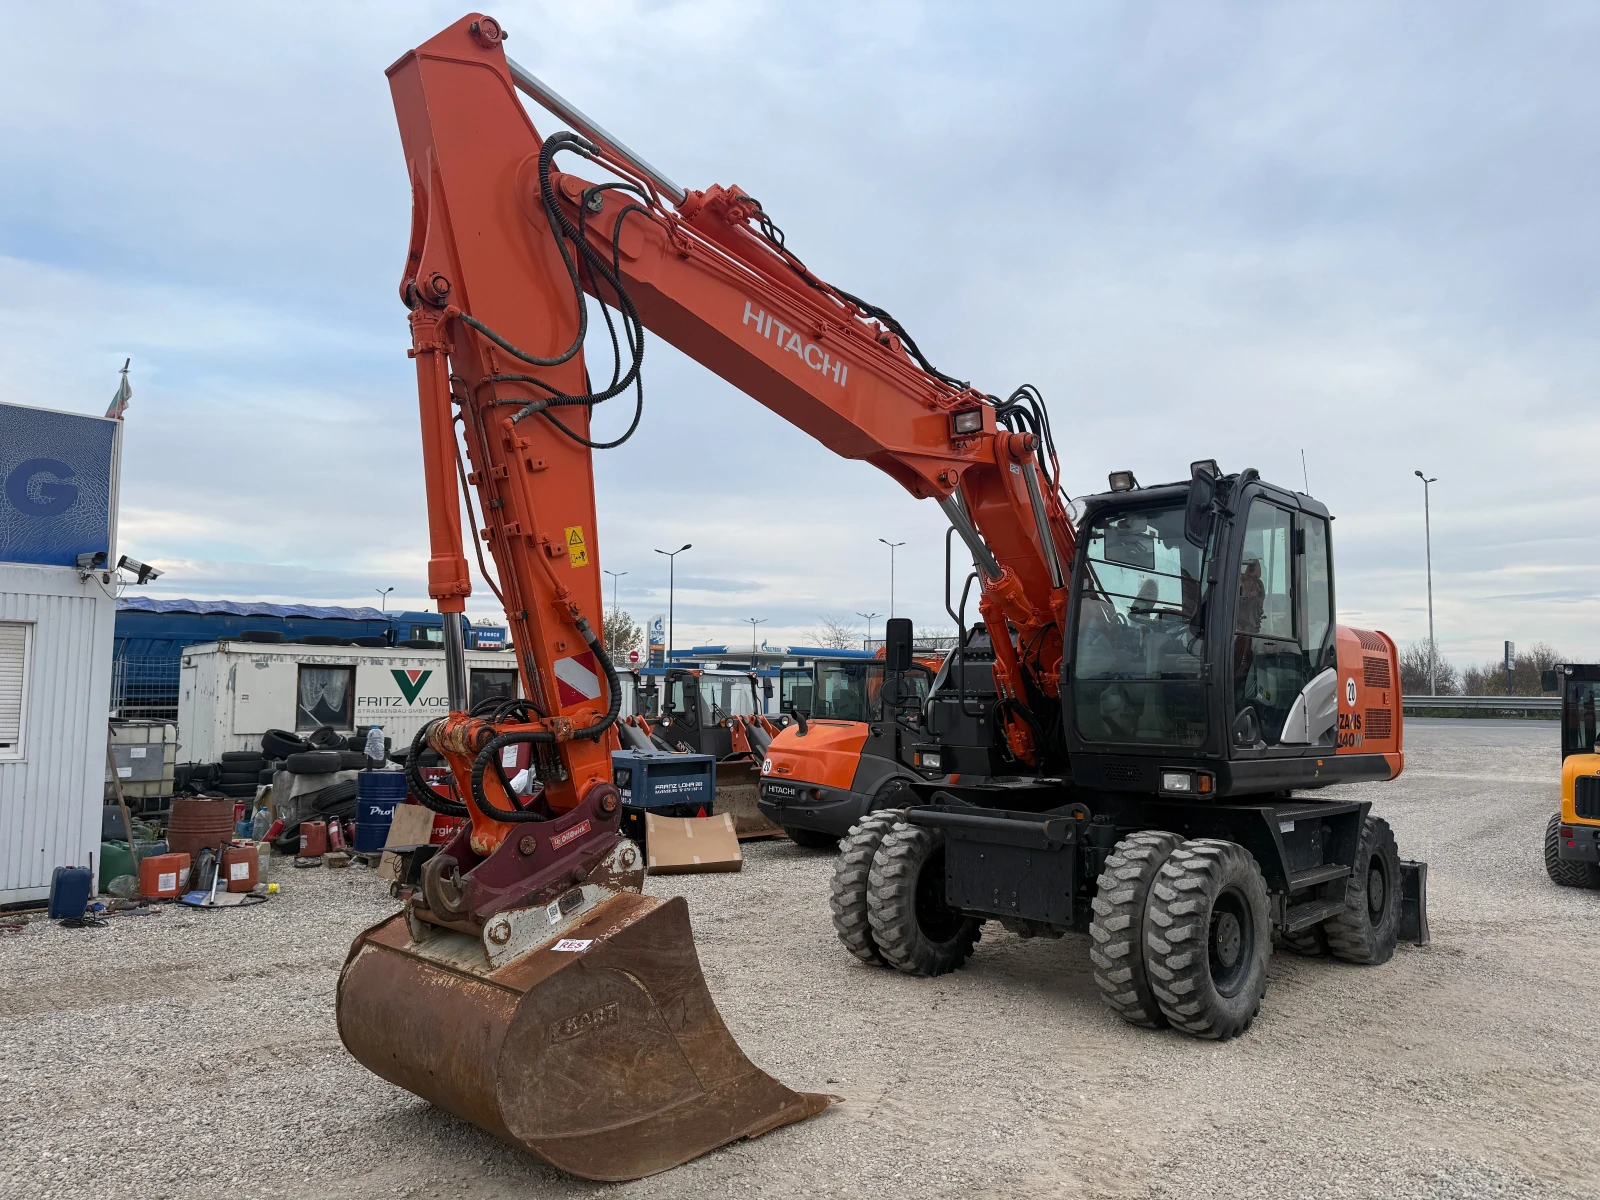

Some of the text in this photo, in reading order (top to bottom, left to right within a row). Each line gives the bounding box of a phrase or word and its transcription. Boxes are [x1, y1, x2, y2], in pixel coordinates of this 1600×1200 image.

[742, 300, 848, 387] HITACHI
[6, 457, 78, 517] G
[1347, 682, 1356, 701] 20
[357, 696, 402, 706] FRITZ
[1339, 710, 1361, 730] ZAXIS
[1338, 733, 1363, 747] 140W
[763, 760, 771, 771] 20
[768, 785, 796, 796] HITACHI
[558, 941, 585, 949] RES
